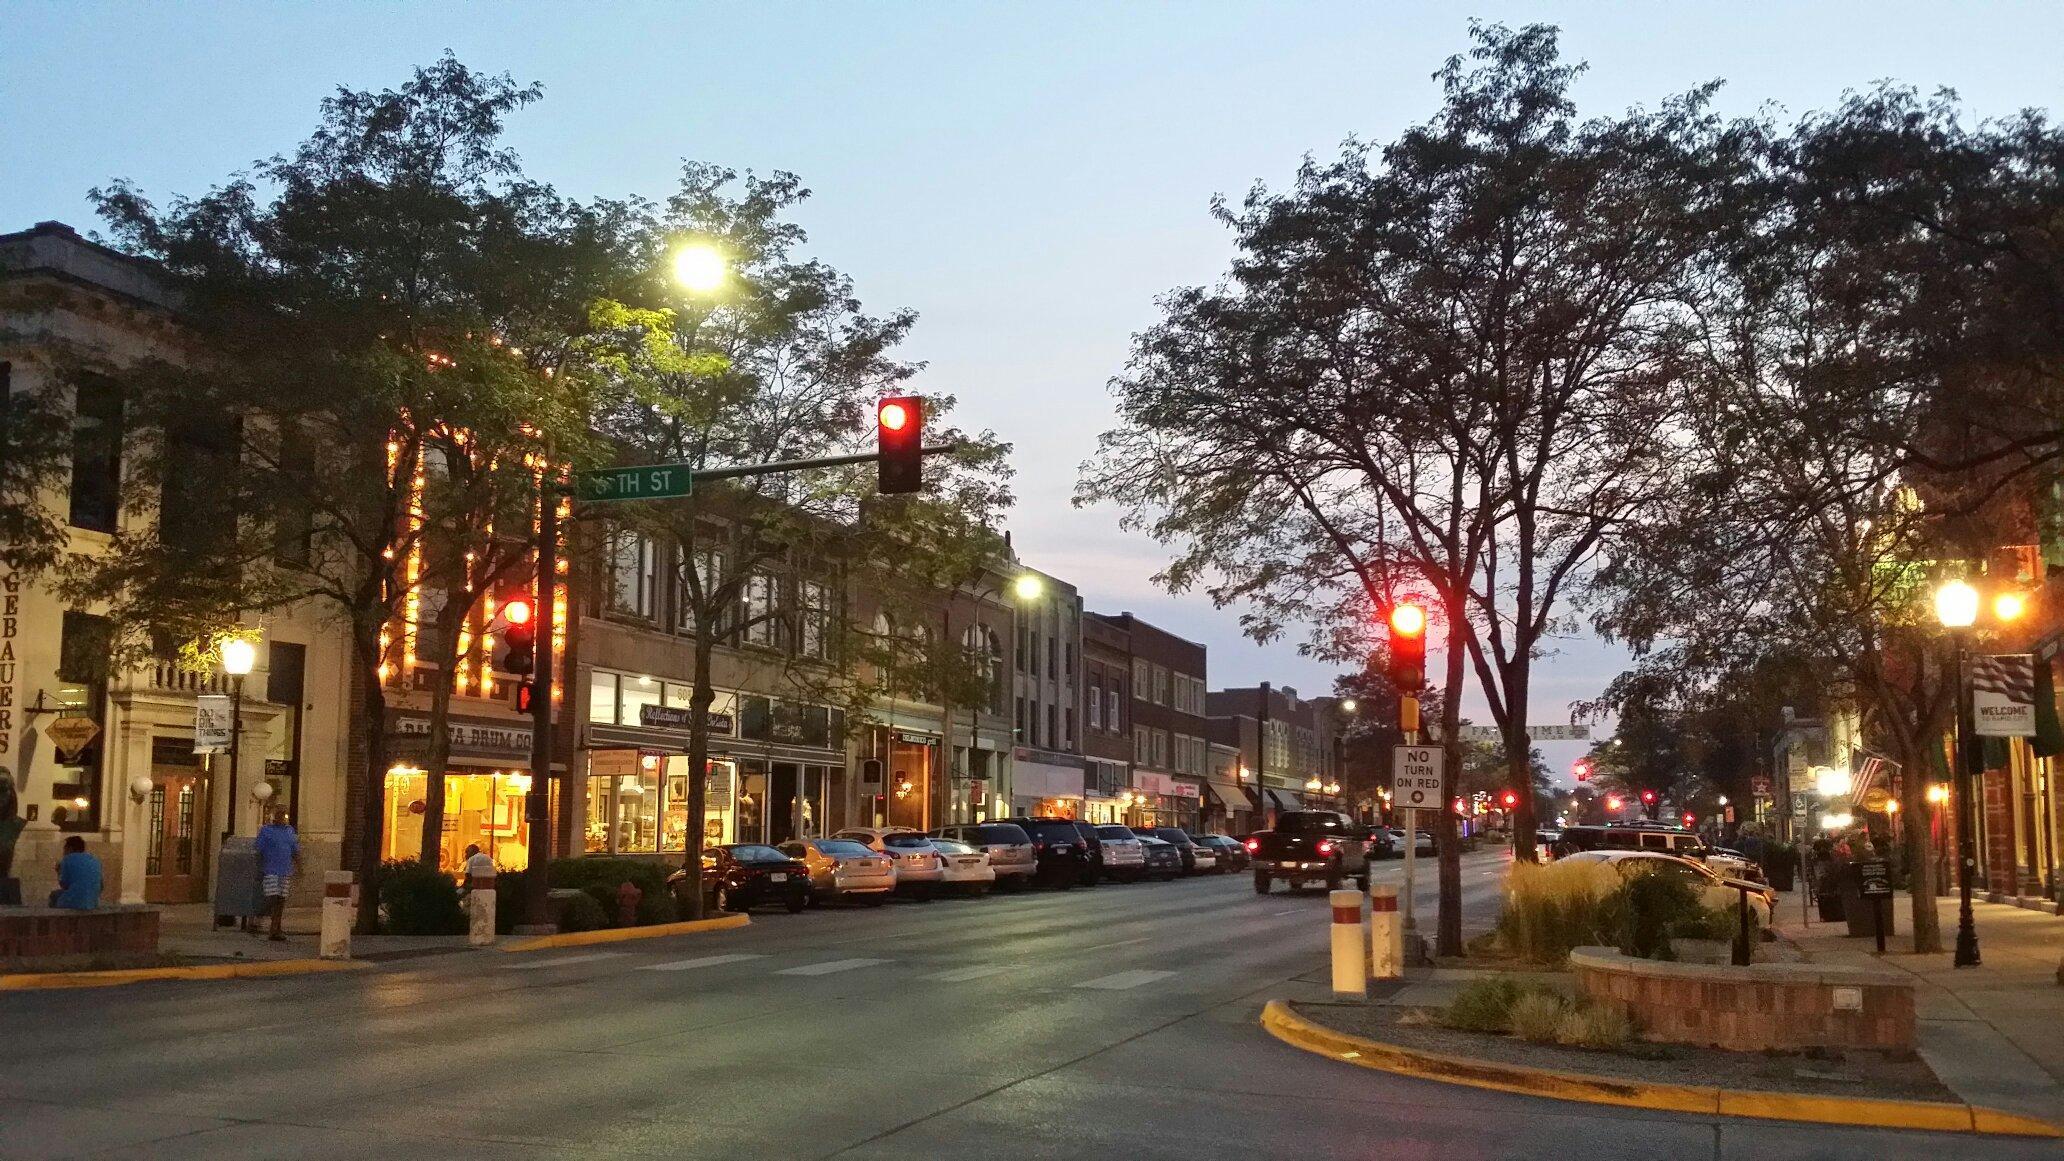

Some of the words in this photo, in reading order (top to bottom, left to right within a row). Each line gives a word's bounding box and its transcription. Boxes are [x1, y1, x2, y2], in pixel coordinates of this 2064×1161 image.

[651, 470, 673, 491] ST
[1981, 705, 2028, 716] WELCOME
[471, 728, 512, 747] DRUM
[516, 733, 531, 748] CO
[1407, 750, 1429, 763] NO
[1403, 765, 1433, 776] TURN
[1396, 777, 1412, 788] ON
[1417, 778, 1439, 789] RED
